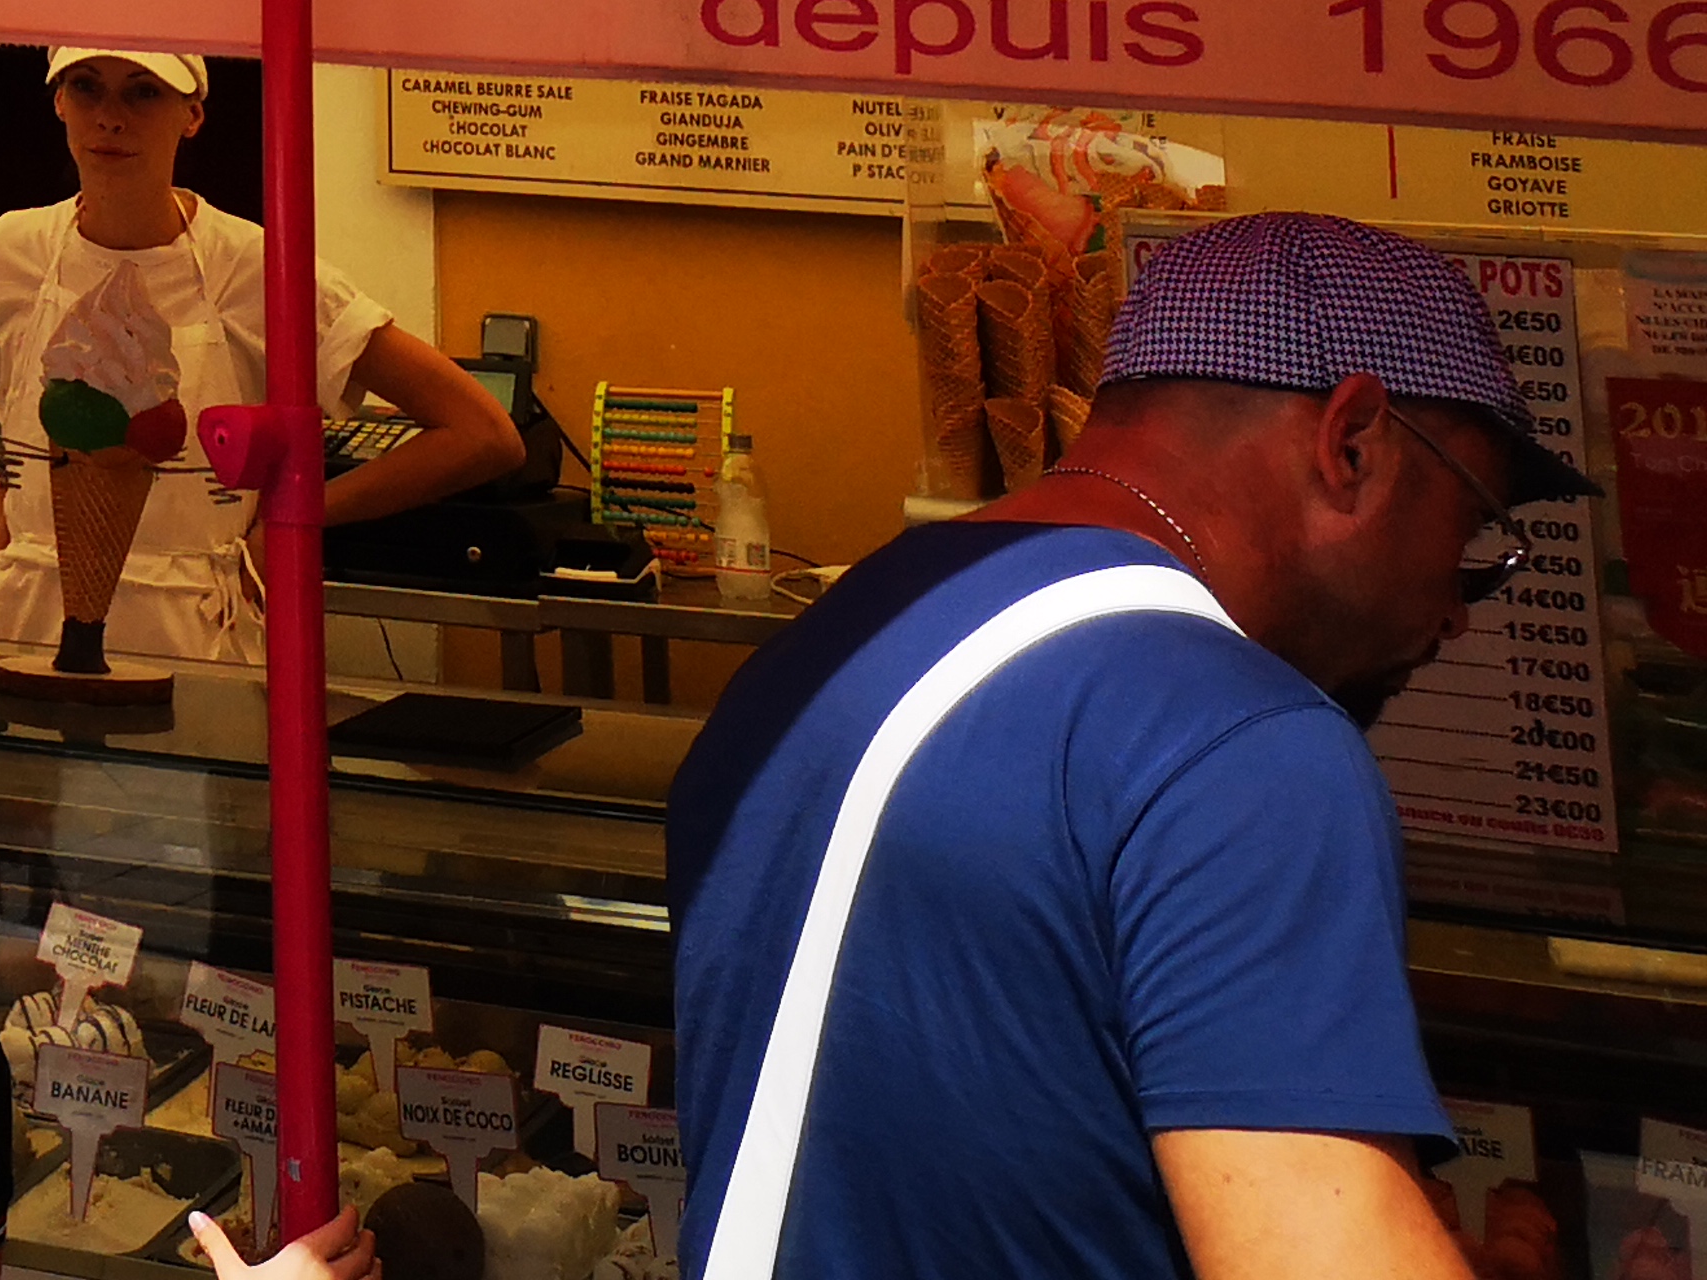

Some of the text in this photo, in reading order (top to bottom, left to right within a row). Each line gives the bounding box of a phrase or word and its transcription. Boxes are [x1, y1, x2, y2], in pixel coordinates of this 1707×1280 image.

[402, 79, 572, 100] CARAMEL BEURRE SALE
[640, 91, 763, 109] FRAISE TAGADA
[432, 100, 542, 118] CHEWING-GUM
[449, 122, 528, 138] CHOCOLAT
[660, 113, 743, 129] GIANDUJA
[423, 140, 555, 160] CHOCOLAT BLANC
[656, 132, 749, 150] GINGEMBRE
[837, 142, 876, 157] PAIN
[1493, 131, 1556, 148] FRAISE
[636, 152, 770, 172] GRAND MARNIER
[1471, 152, 1581, 172] FRAMBOISE
[1488, 176, 1566, 194] GOYAVE
[1488, 199, 1569, 217] GRIOTTE
[1480, 260, 1563, 297] POTS
[1498, 310, 1560, 332] 2€50
[1520, 381, 1567, 402] €50
[1501, 586, 1584, 611] 14€00
[1504, 621, 1587, 646] 15€50
[1507, 657, 1589, 681] 17€00
[1510, 691, 1592, 717] 18€50
[1510, 725, 1595, 752] 20€00
[1516, 761, 1599, 787] 21€50
[1516, 795, 1601, 821] 23€00
[186, 993, 226, 1021] FLEUR
[230, 1010, 248, 1028] DE
[340, 992, 417, 1014] PISTACHE
[550, 1060, 633, 1092] REGLISSE
[51, 1081, 129, 1109] BANANE
[225, 1098, 262, 1117] FLEUR
[403, 1104, 513, 1131] NOIX DE COCO
